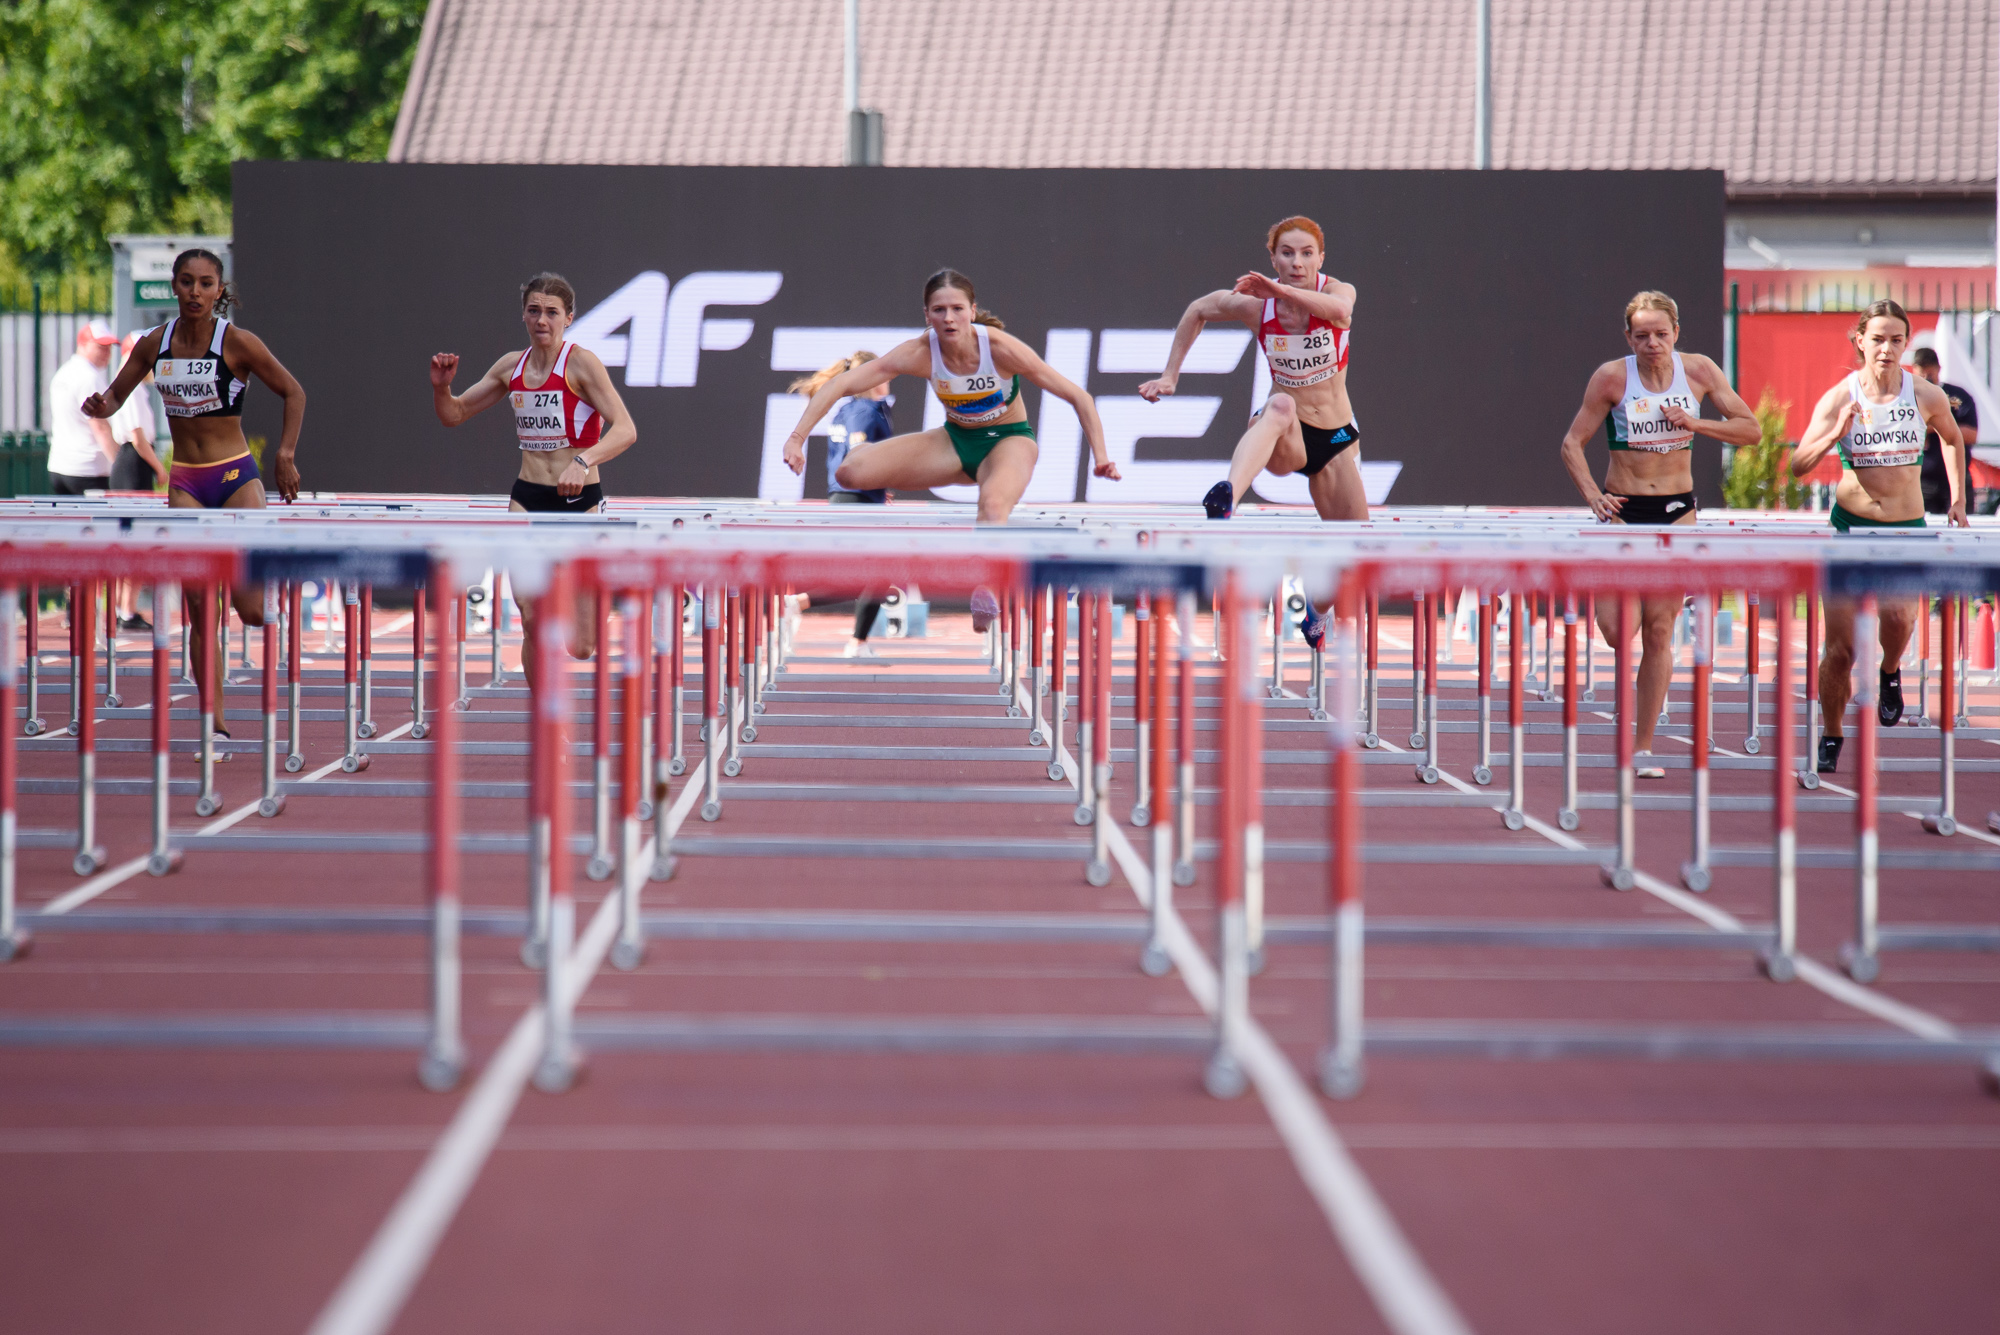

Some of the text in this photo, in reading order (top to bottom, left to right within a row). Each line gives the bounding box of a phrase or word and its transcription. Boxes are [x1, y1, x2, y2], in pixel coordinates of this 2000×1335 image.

[1302, 332, 1330, 349] 285
[186, 361, 213, 375] 139
[1275, 353, 1331, 370] SICIARZ
[966, 376, 996, 391] 205
[1276, 375, 1309, 387] SUWAŁKI
[1310, 371, 1328, 383] 2022
[156, 383, 214, 397] MAJEWSKA
[534, 393, 559, 407] 274
[1664, 396, 1690, 409] 151
[191, 404, 210, 416] 2022
[1888, 408, 1915, 422] 199
[1854, 430, 1918, 446] ODOWSKA
[541, 442, 557, 450] 2022
[1857, 455, 1908, 465] SUWAŁKI 2022
